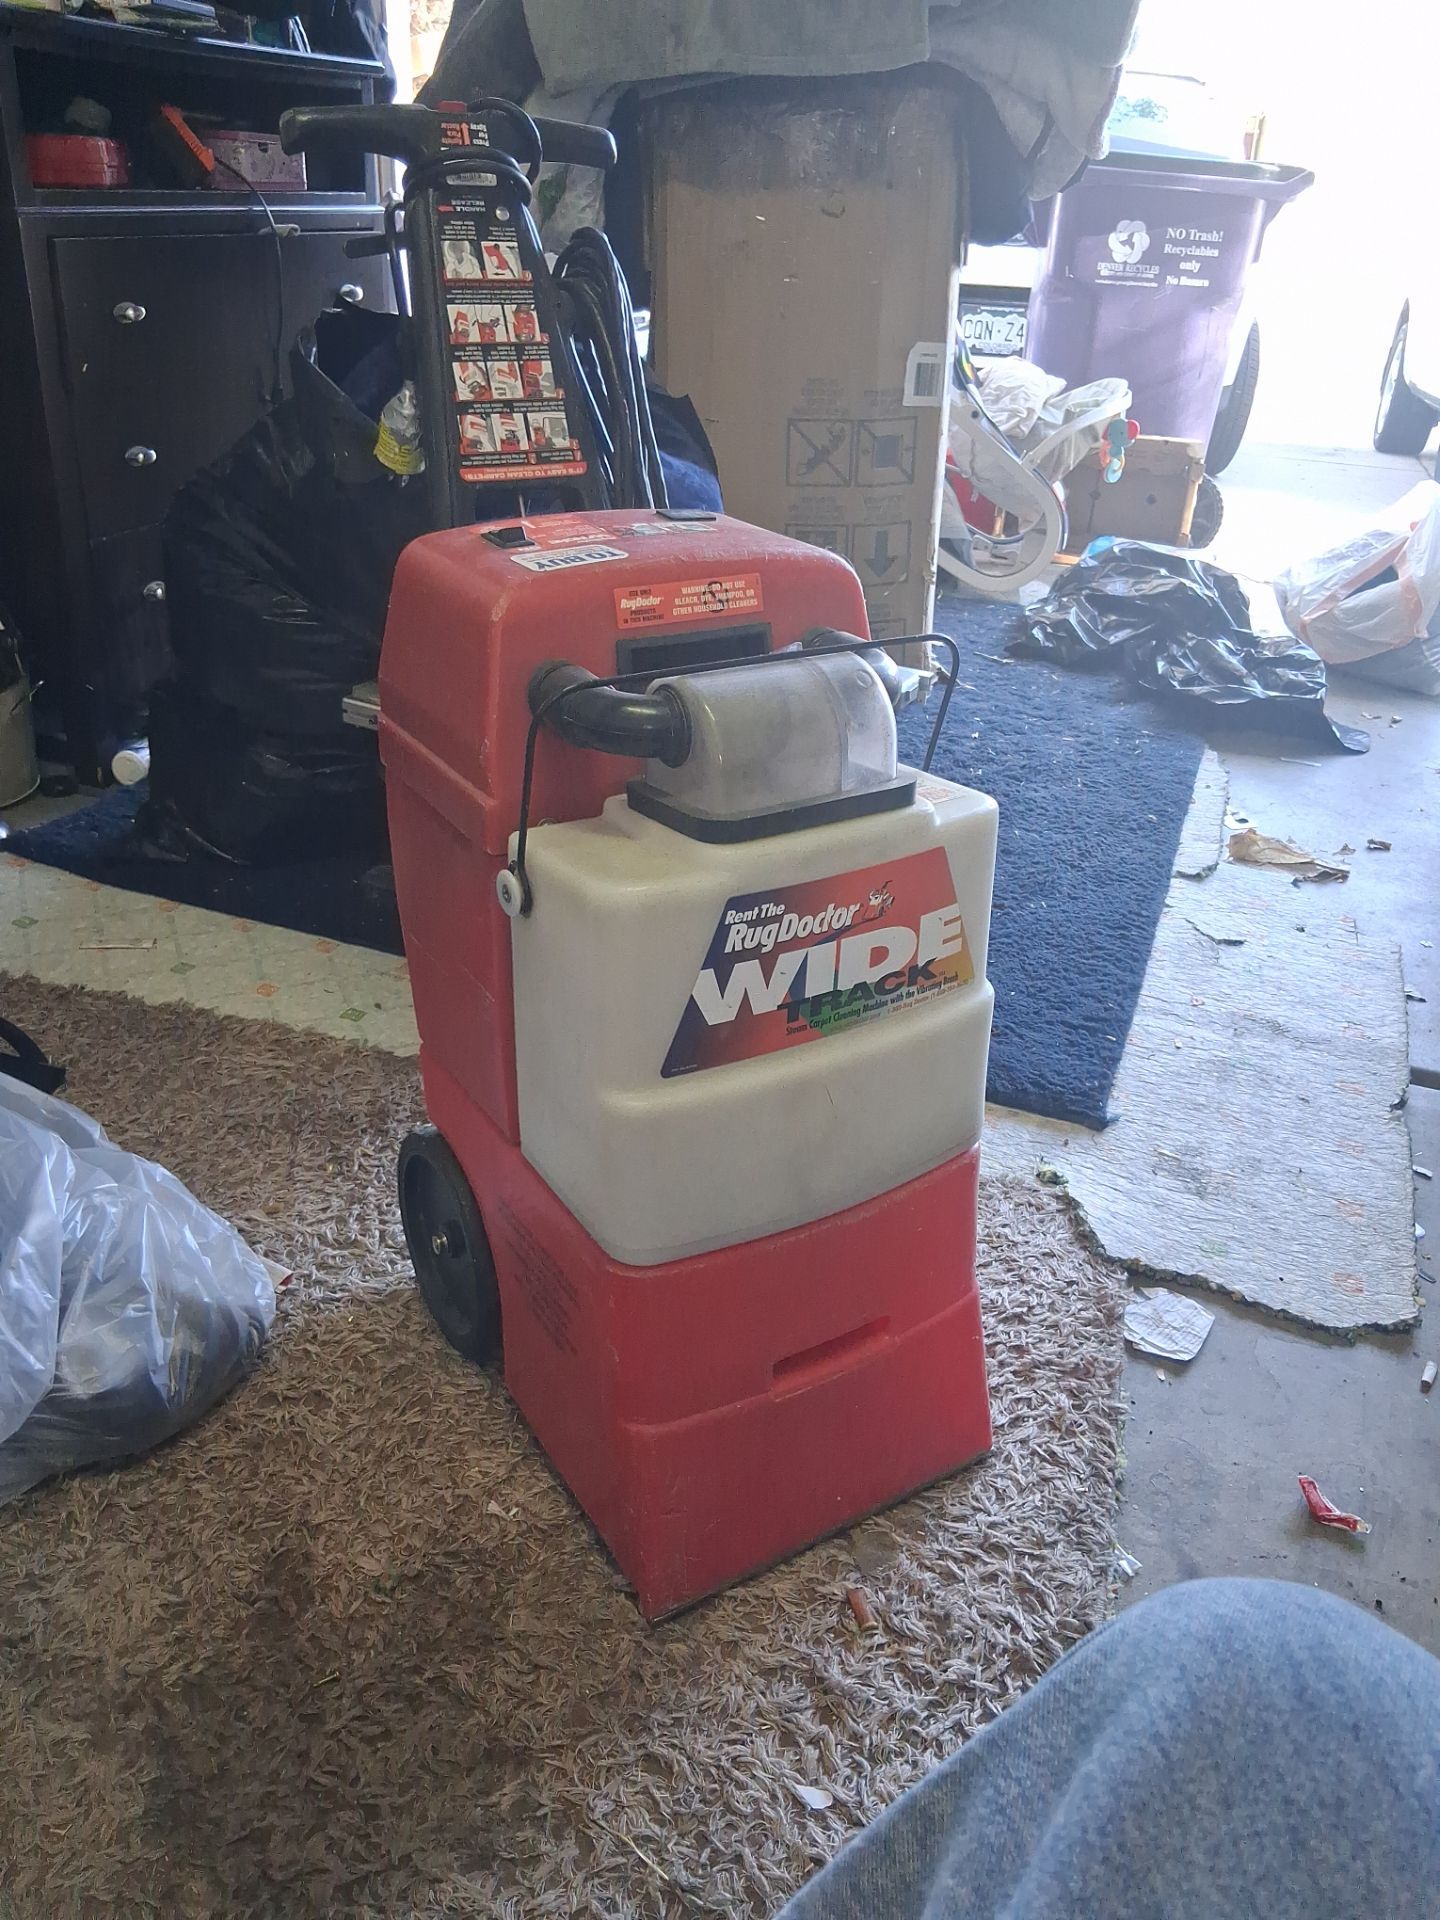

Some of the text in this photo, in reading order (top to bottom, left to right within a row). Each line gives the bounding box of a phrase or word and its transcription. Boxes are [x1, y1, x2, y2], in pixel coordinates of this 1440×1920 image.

[1165, 227, 1224, 242] NO Trash!
[1163, 243, 1219, 257] Recyclables
[1125, 263, 1160, 274] RECYCLES
[1179, 260, 1201, 273] only
[1165, 275, 1178, 286] No
[506, 470, 534, 478] CLEAN
[547, 468, 568, 476] EASY
[533, 554, 584, 570] BUY
[585, 550, 622, 560] TO
[734, 580, 745, 588] USE
[746, 589, 755, 597] OR
[621, 595, 662, 610] RugDoctor
[672, 606, 692, 616] OTHER
[728, 598, 758, 608] CLEANERS
[630, 608, 656, 616] PRODUCTS
[724, 902, 786, 926] Rent The
[724, 903, 861, 954] RugDoctor
[691, 903, 963, 1026] WIDE
[777, 957, 938, 1025] TRACK
[786, 1024, 808, 1036] Steam
[809, 1015, 832, 1030] Carpet
[833, 1008, 861, 1021] Cleaning
[862, 998, 889, 1012] Machine
[890, 993, 904, 1004] with
[906, 990, 916, 998] the
